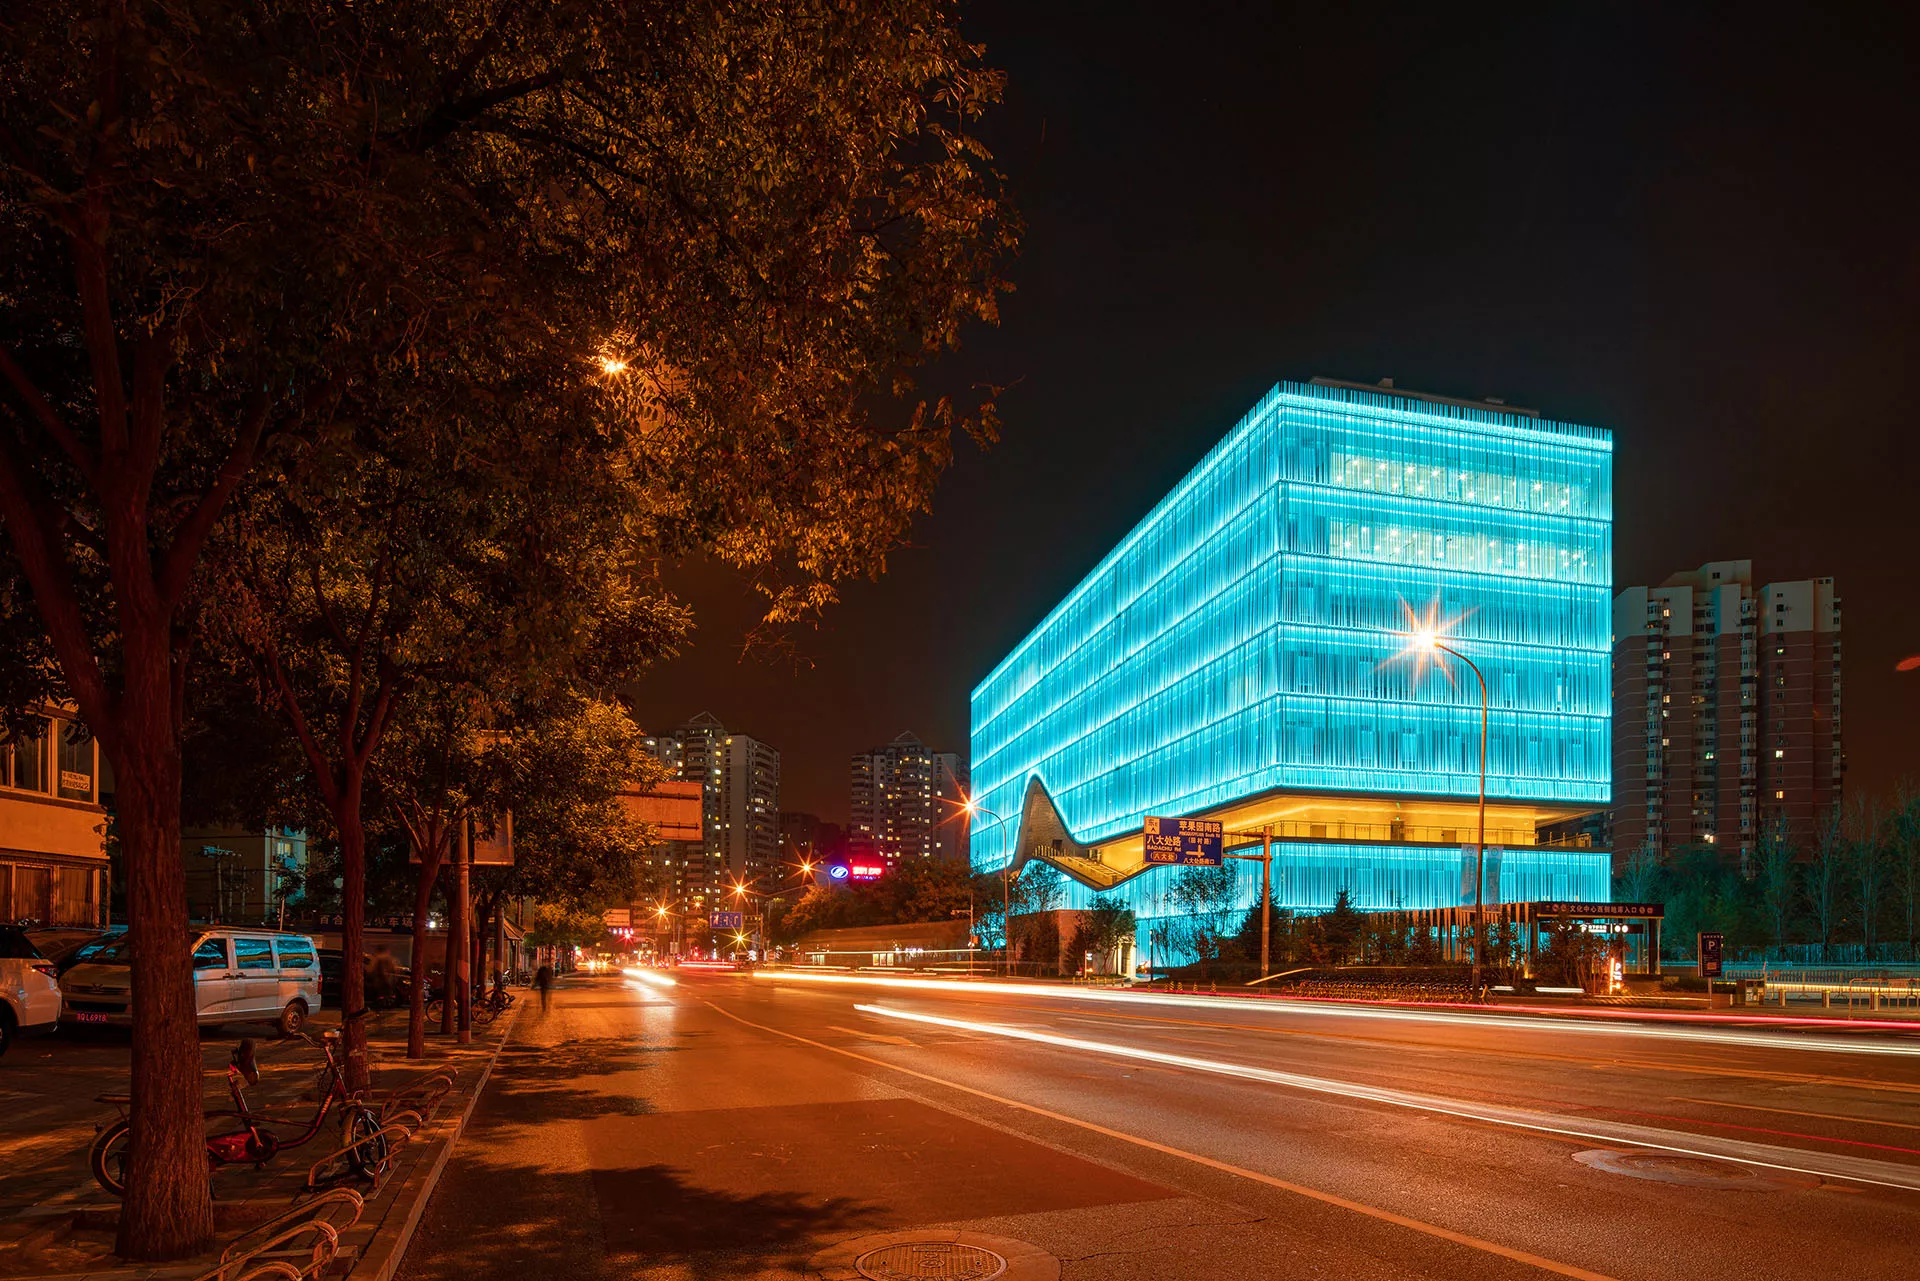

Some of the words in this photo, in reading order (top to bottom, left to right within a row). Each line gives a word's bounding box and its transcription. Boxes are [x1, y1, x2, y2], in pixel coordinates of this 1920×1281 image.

[1179, 821, 1220, 833] 苹果园南路
[1147, 835, 1181, 847] 八大处路
[1708, 940, 1716, 950] P
